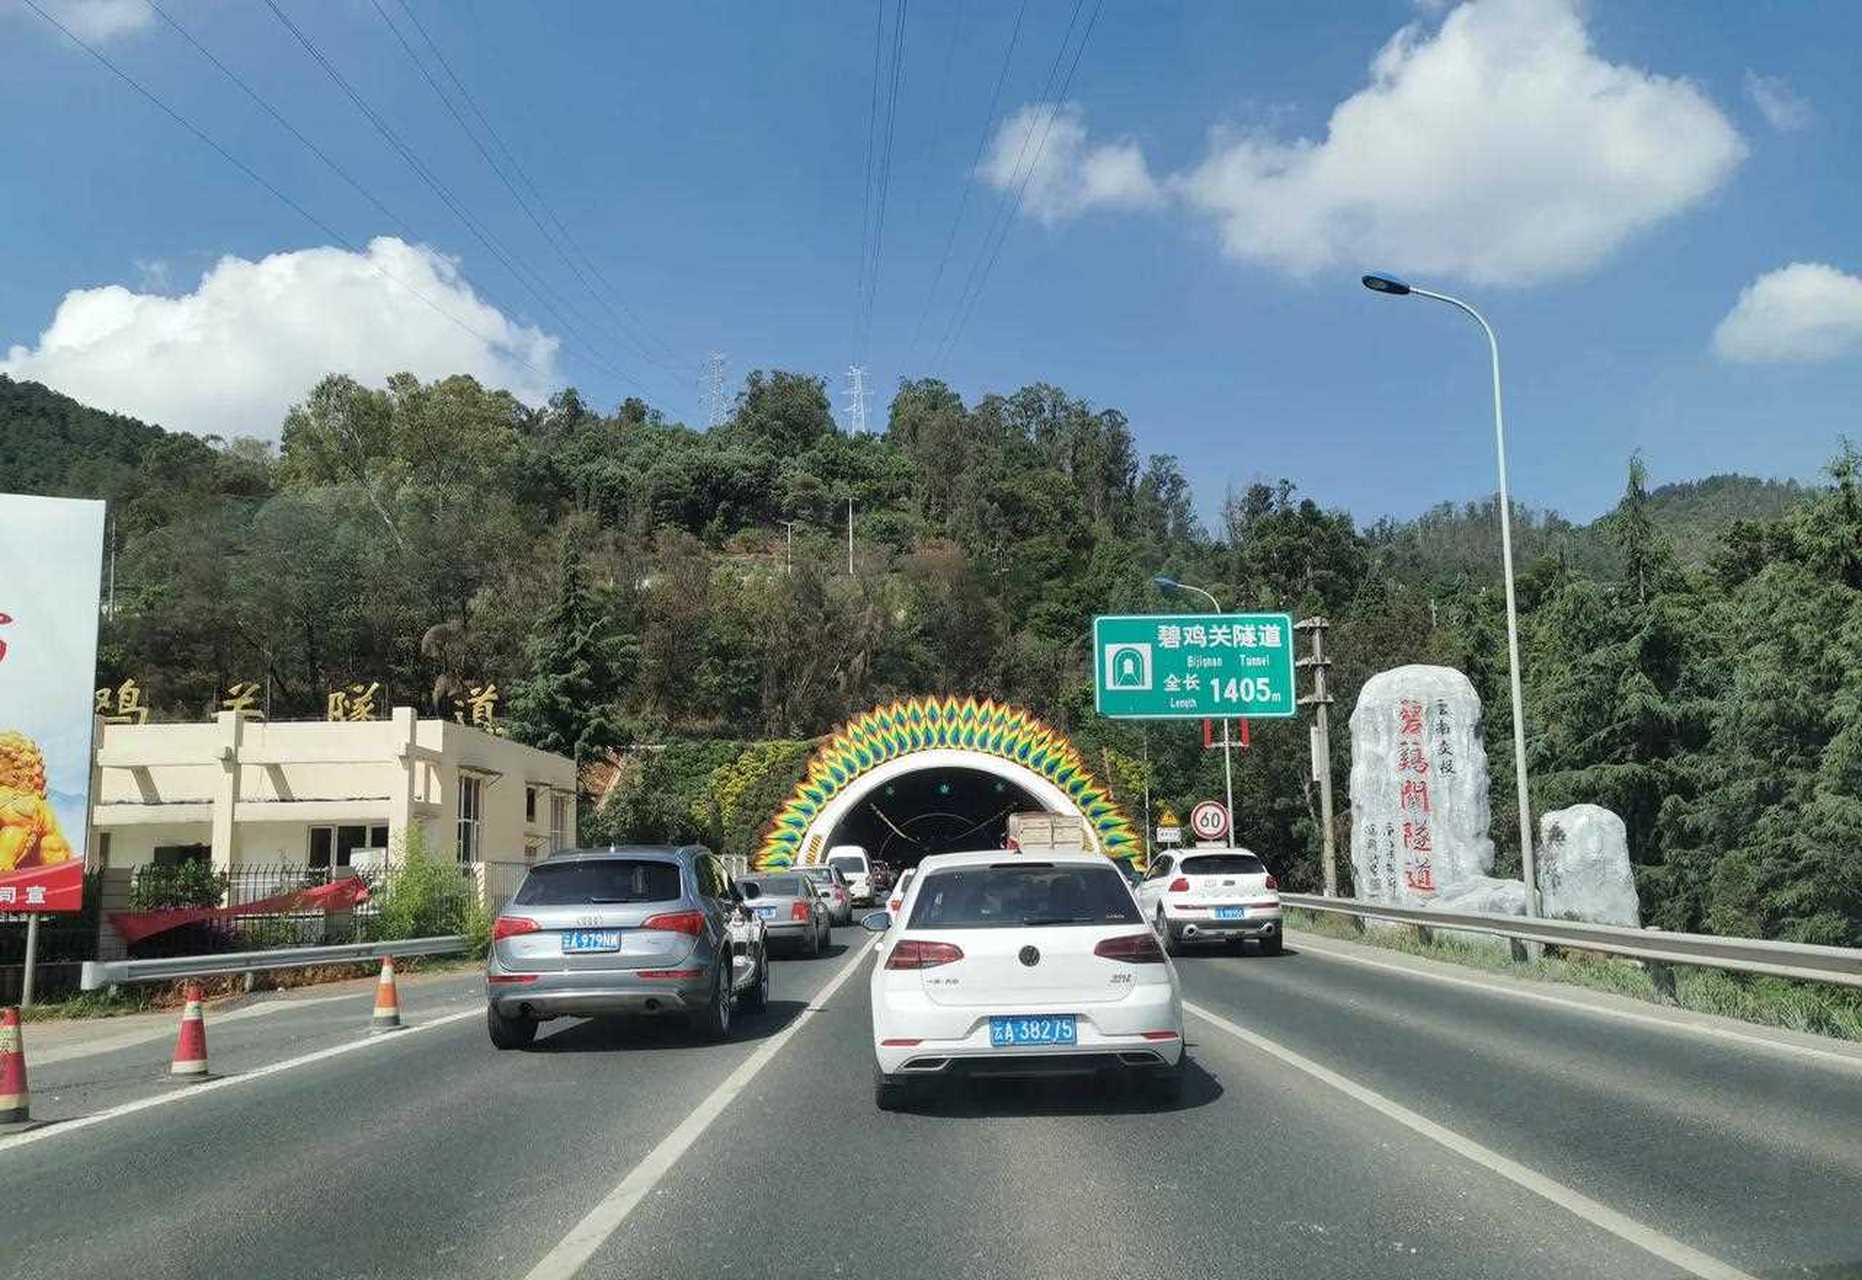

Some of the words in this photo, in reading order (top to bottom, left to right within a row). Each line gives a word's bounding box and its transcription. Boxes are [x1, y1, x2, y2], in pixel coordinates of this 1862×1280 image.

[1158, 625, 1282, 648] 碧鸡关隧道
[1239, 654, 1269, 667] Tunnel
[1163, 673, 1200, 691] 全长
[1210, 677, 1281, 704] 1405m
[1170, 697, 1197, 709] Length
[1200, 812, 1220, 828] 60
